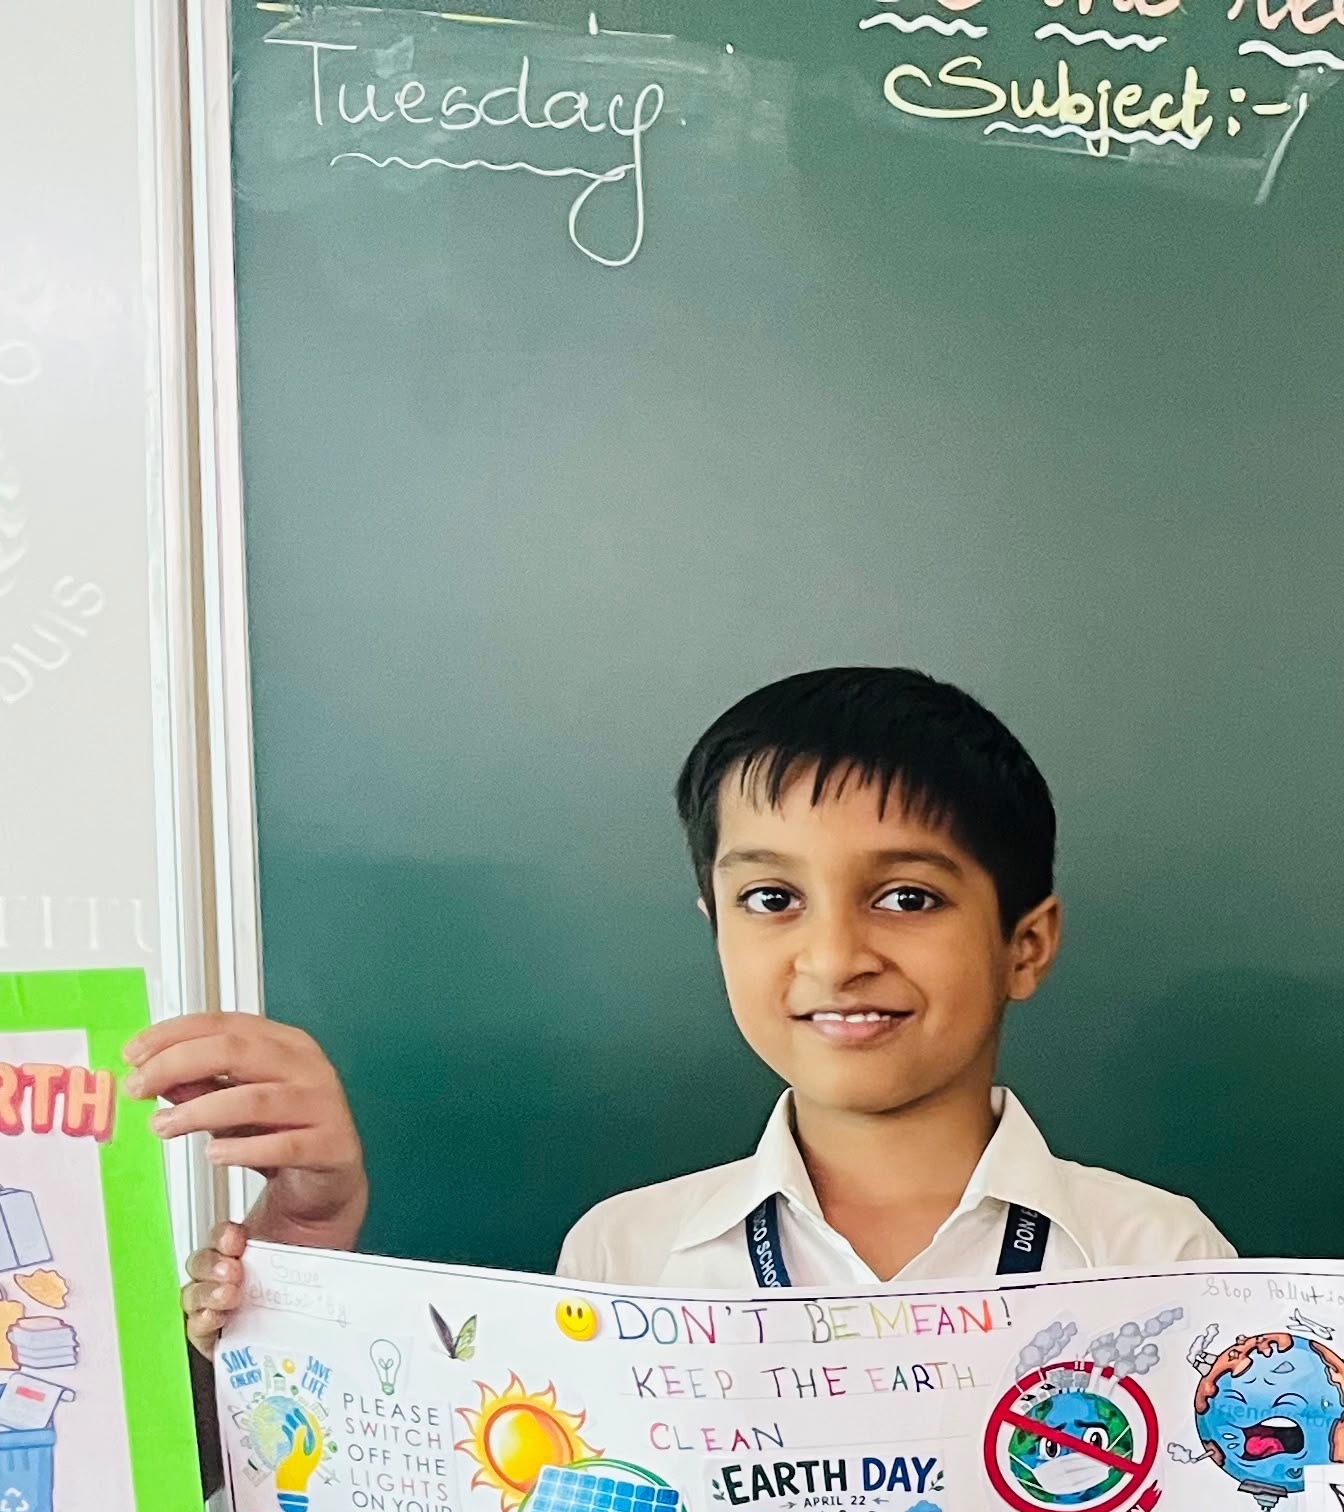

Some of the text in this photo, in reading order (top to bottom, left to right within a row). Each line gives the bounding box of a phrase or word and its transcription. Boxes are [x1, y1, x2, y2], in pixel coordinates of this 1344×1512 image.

[611, 1297, 1012, 1344] DON'T BE MEAN!
[631, 1362, 976, 1398] KEEP THE EARTH
[343, 1392, 441, 1427] PLEASE
[345, 1417, 443, 1450] SWITCH
[650, 1422, 786, 1452] CLEAN
[347, 1444, 447, 1477] OFF THE
[350, 1473, 449, 1502] LIGHTS
[722, 1457, 937, 1506] EARTH DAY
[352, 1490, 385, 1512] ON
[803, 1495, 866, 1508] APRIL 22
